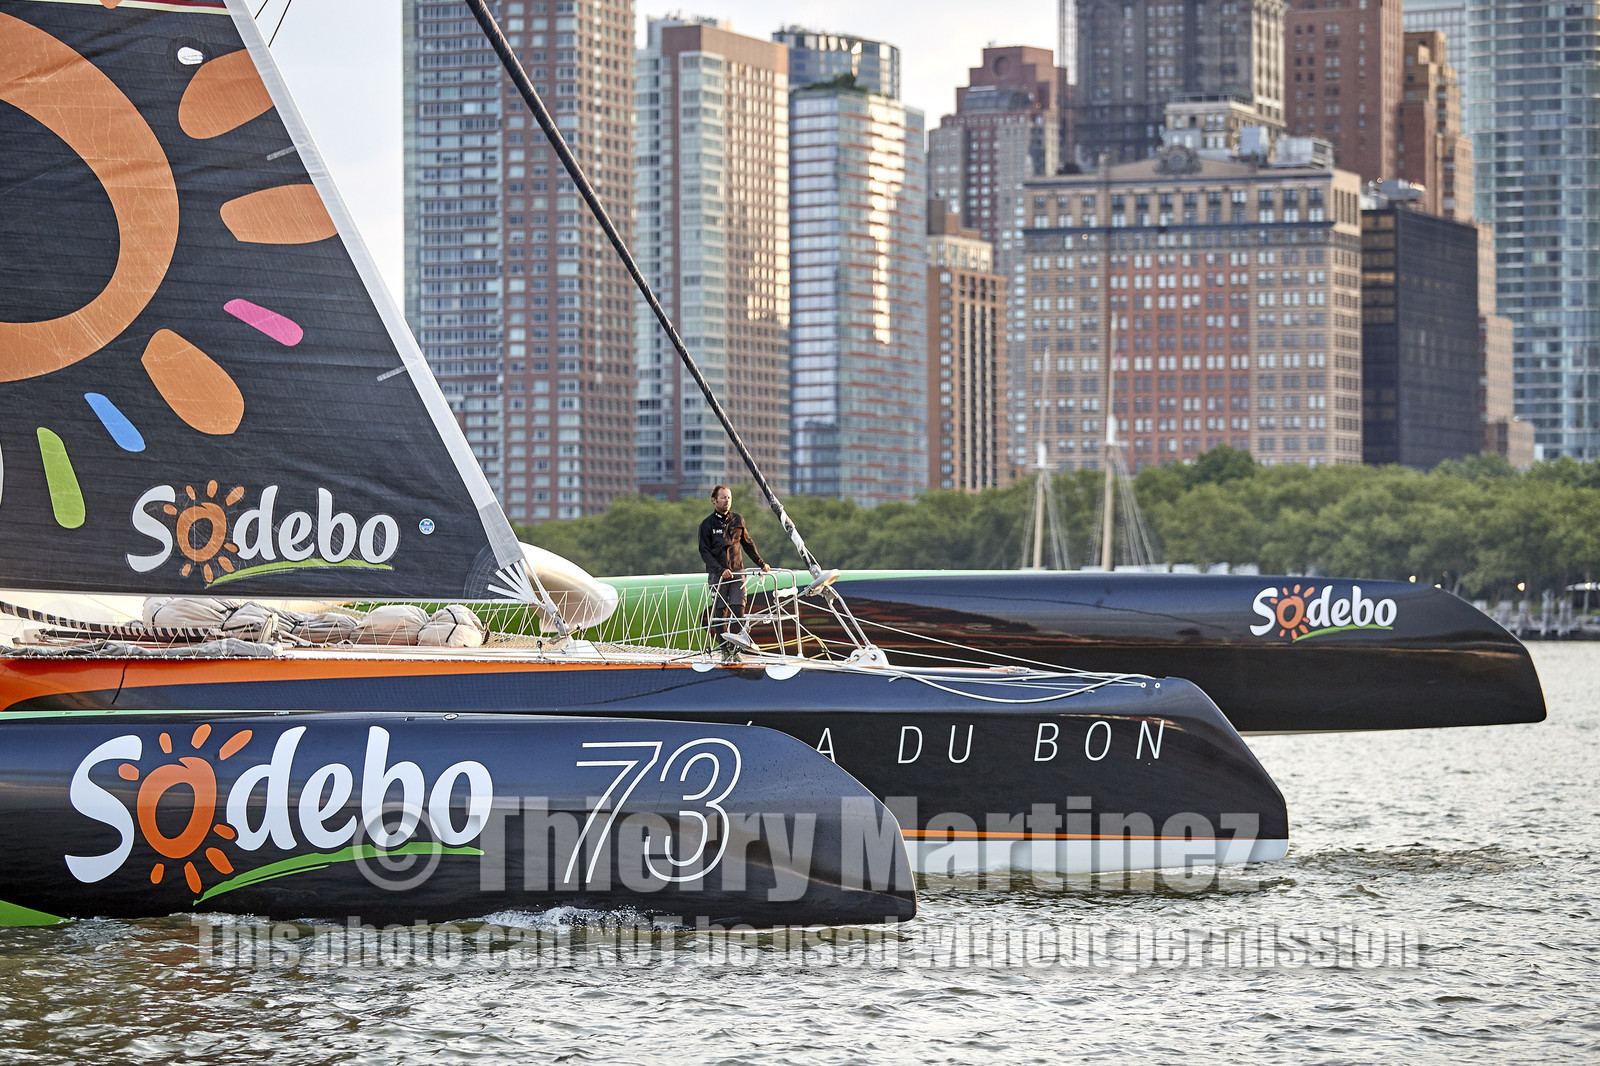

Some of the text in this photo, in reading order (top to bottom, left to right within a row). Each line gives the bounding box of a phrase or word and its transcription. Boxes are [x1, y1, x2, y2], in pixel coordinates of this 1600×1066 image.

[126, 484, 400, 574] Sodebo
[1249, 584, 1397, 638] Sodebo
[897, 724, 975, 764] DU
[1034, 719, 1165, 763] BON
[64, 725, 494, 884] Sodebo
[564, 738, 742, 884] 73
